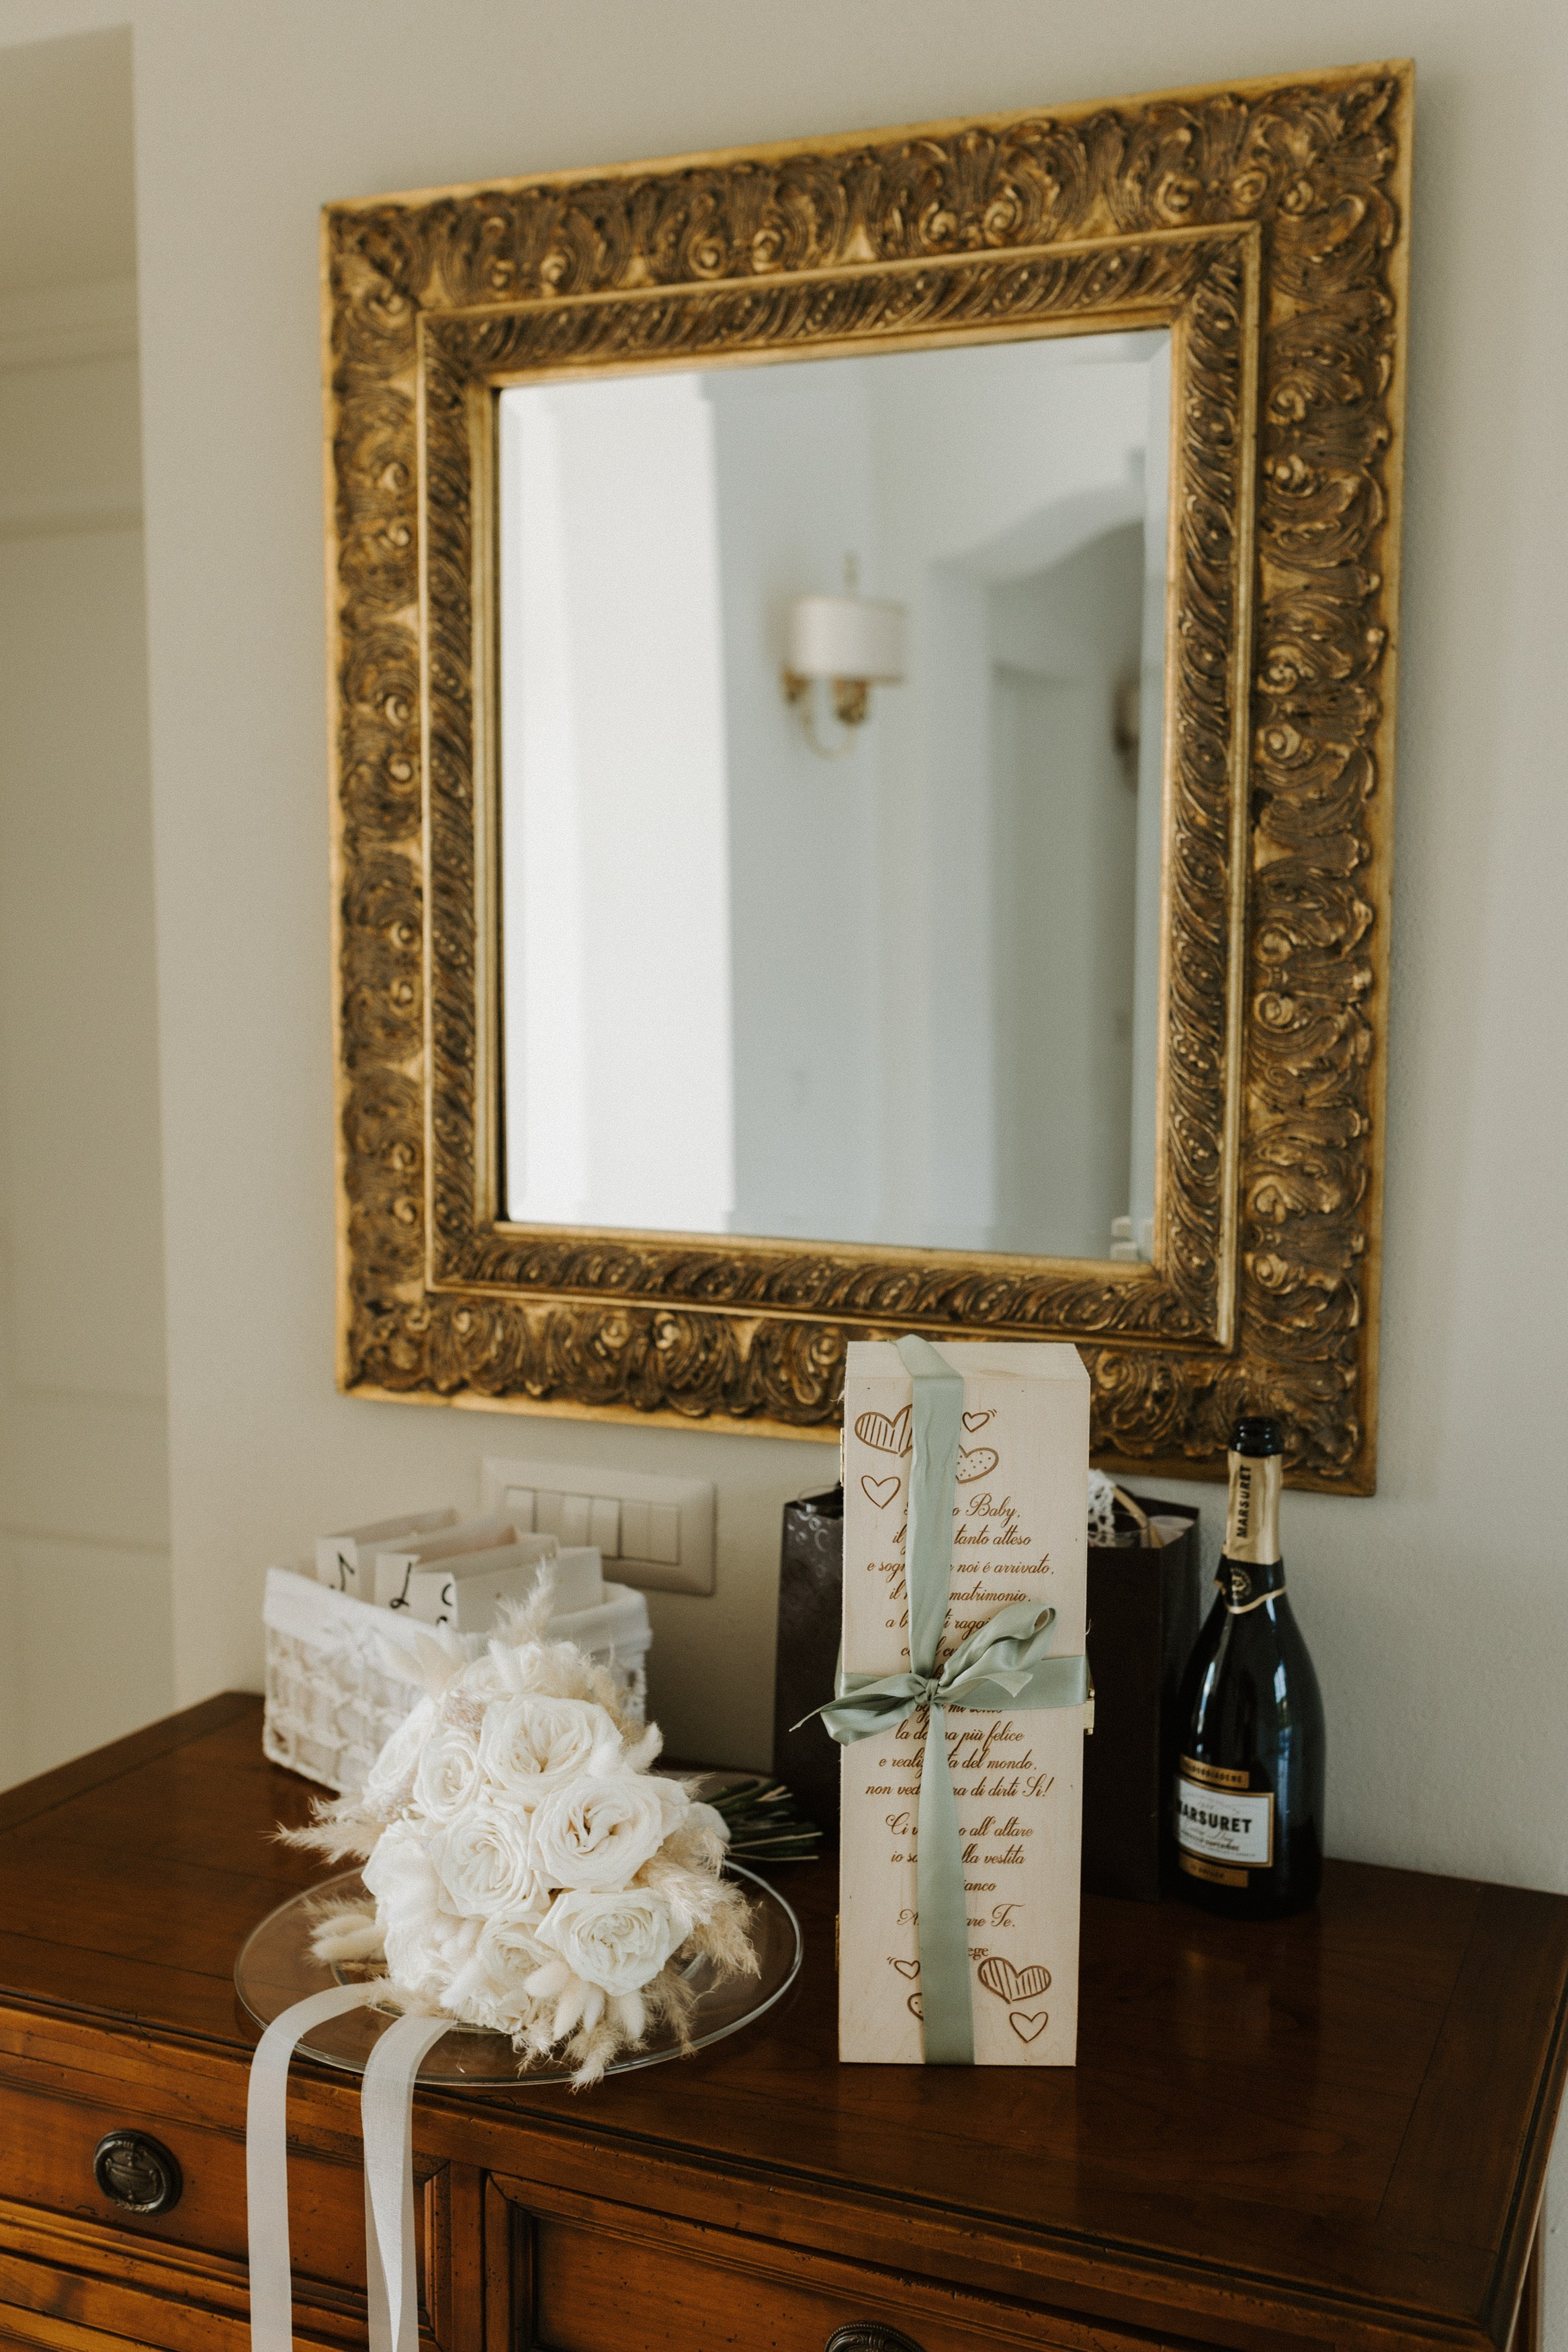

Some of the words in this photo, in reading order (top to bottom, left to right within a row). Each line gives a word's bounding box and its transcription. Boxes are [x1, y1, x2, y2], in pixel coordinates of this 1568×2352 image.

[965, 1493, 1020, 1528] Baby,
[1236, 1465, 1252, 1538] MARSURET
[954, 1524, 990, 1545] tanto
[993, 1525, 1033, 1545] atteso
[867, 1562, 876, 1571] e
[957, 1561, 981, 1573] noi
[994, 1553, 1055, 1574] arrivato,
[889, 1579, 906, 1599] il
[949, 1581, 1031, 1602] matrimonio.
[885, 1620, 896, 1628] a
[896, 1719, 911, 1739] la
[953, 1729, 986, 1752] più
[982, 1720, 1025, 1751] felice
[879, 1758, 887, 1767] e
[962, 1748, 990, 1769] del
[986, 1749, 1037, 1770] mondo,
[865, 1786, 893, 1795] non
[971, 1776, 986, 1796] di
[988, 1776, 1020, 1797] dirti
[885, 1812, 910, 1835] Ci
[891, 1851, 905, 1863] io
[984, 1844, 1026, 1864] vestita
